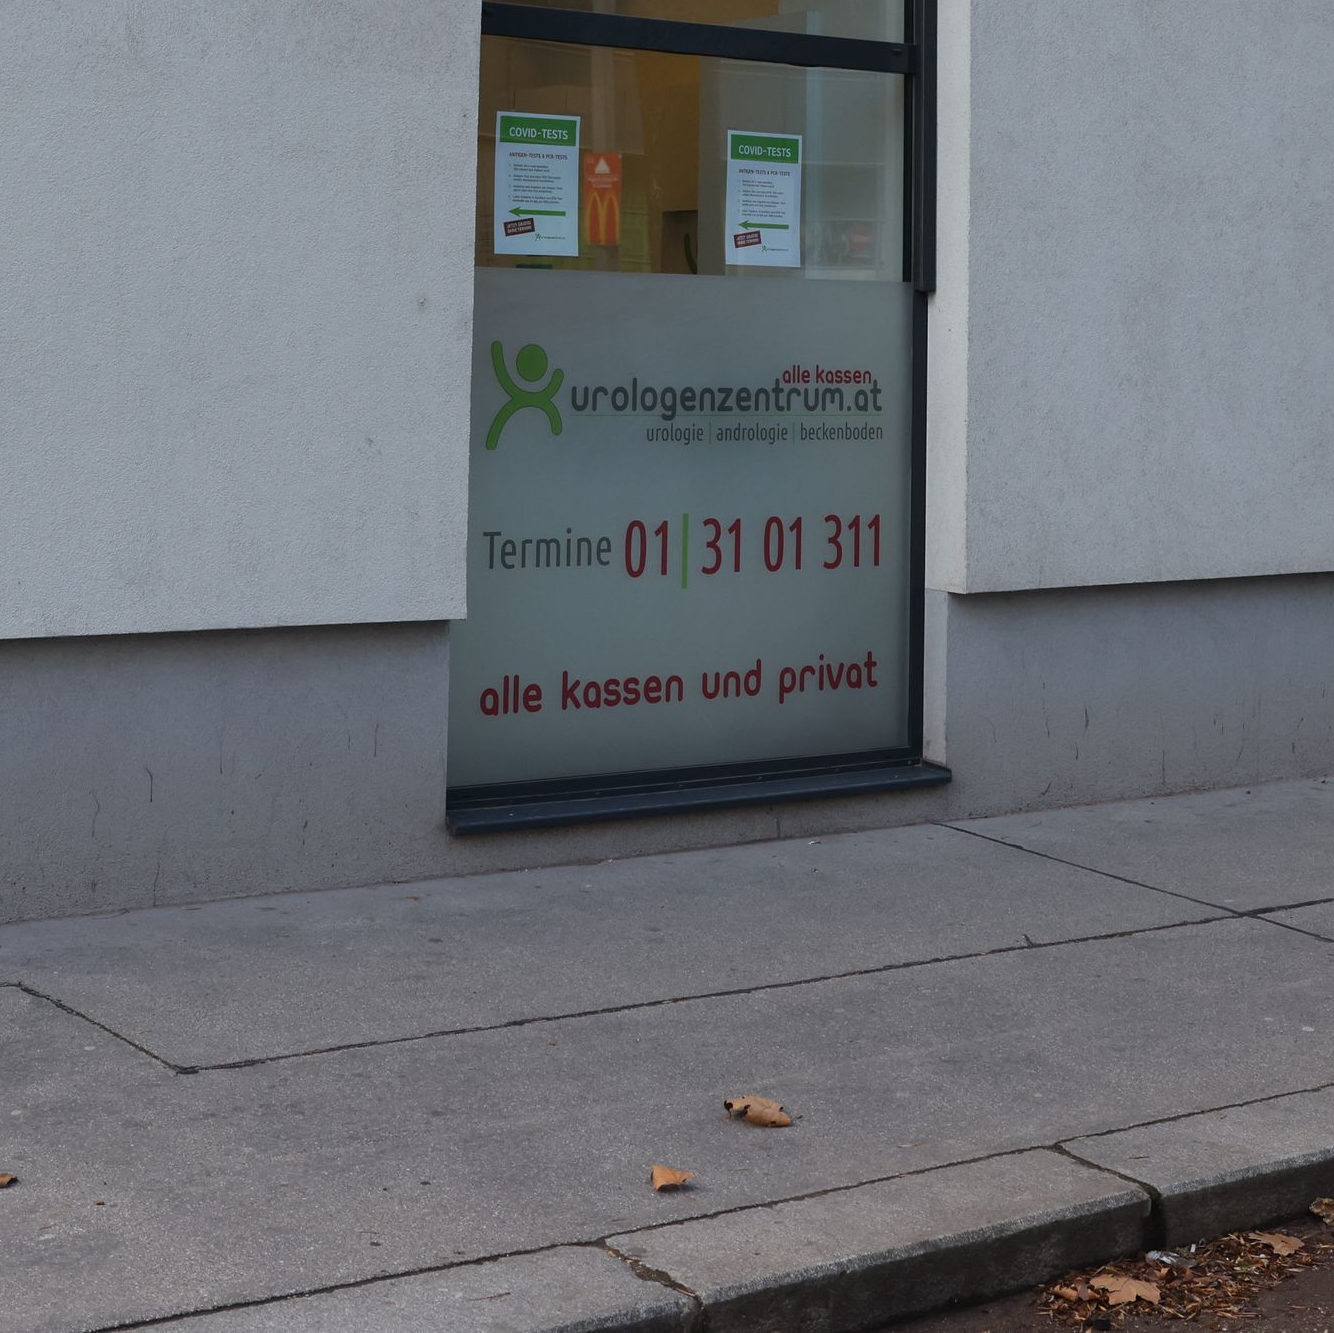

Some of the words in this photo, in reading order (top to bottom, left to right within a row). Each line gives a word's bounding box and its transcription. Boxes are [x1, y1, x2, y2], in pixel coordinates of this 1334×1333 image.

[509, 126, 569, 141] COVID-TESTS
[738, 144, 792, 158] COVID-TESTS
[782, 363, 810, 385] alle
[816, 364, 872, 385] kassen
[570, 377, 883, 422] urologenzentrum.at
[646, 421, 704, 446] urologie
[715, 419, 788, 444] andrologie
[800, 420, 884, 443] beckenboden
[482, 527, 613, 570] Termine
[623, 519, 669, 579] 01
[701, 516, 743, 576] 31
[763, 514, 803, 573] 01
[822, 512, 882, 570] 311
[479, 673, 543, 717] alle
[560, 670, 684, 711] kassen
[701, 658, 762, 700] und
[778, 651, 878, 705] privat
